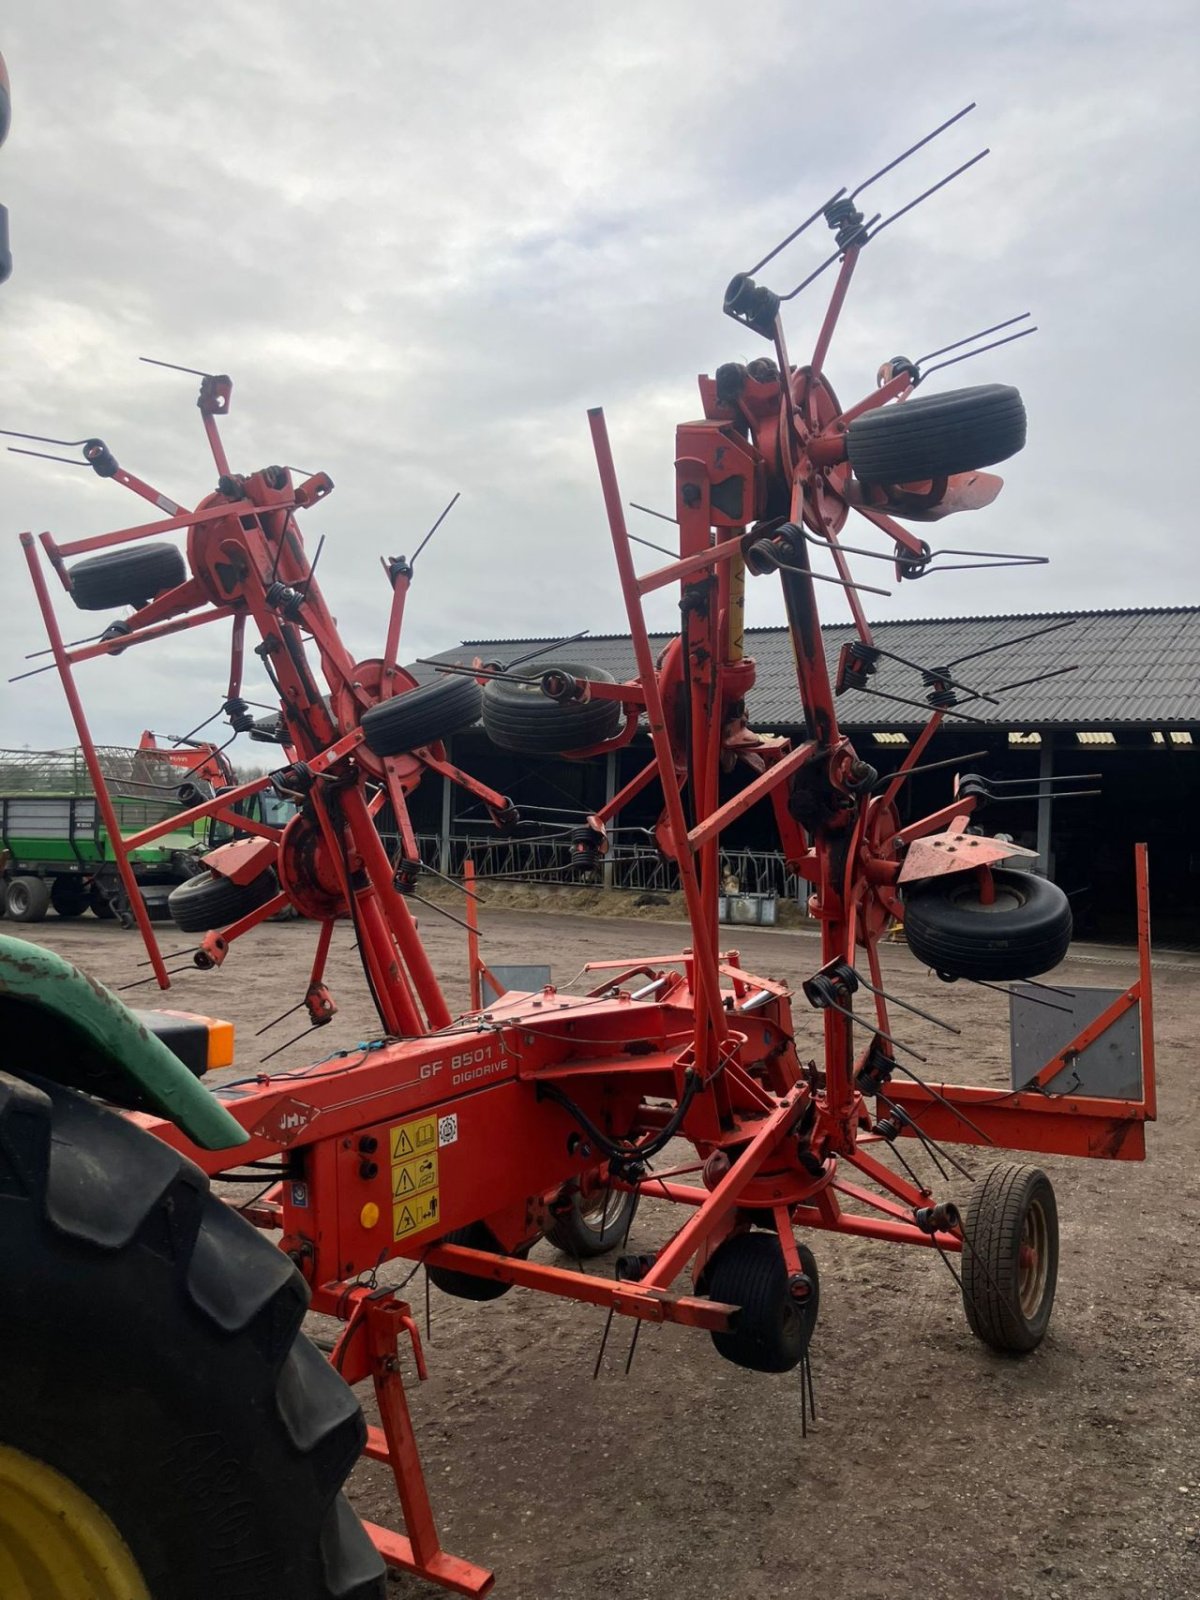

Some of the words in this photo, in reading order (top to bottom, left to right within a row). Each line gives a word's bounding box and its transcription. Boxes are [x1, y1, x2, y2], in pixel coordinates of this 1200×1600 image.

[420, 1061, 443, 1080] GF
[451, 1046, 492, 1070] 8501
[452, 1059, 509, 1086] DIGIDRIVE
